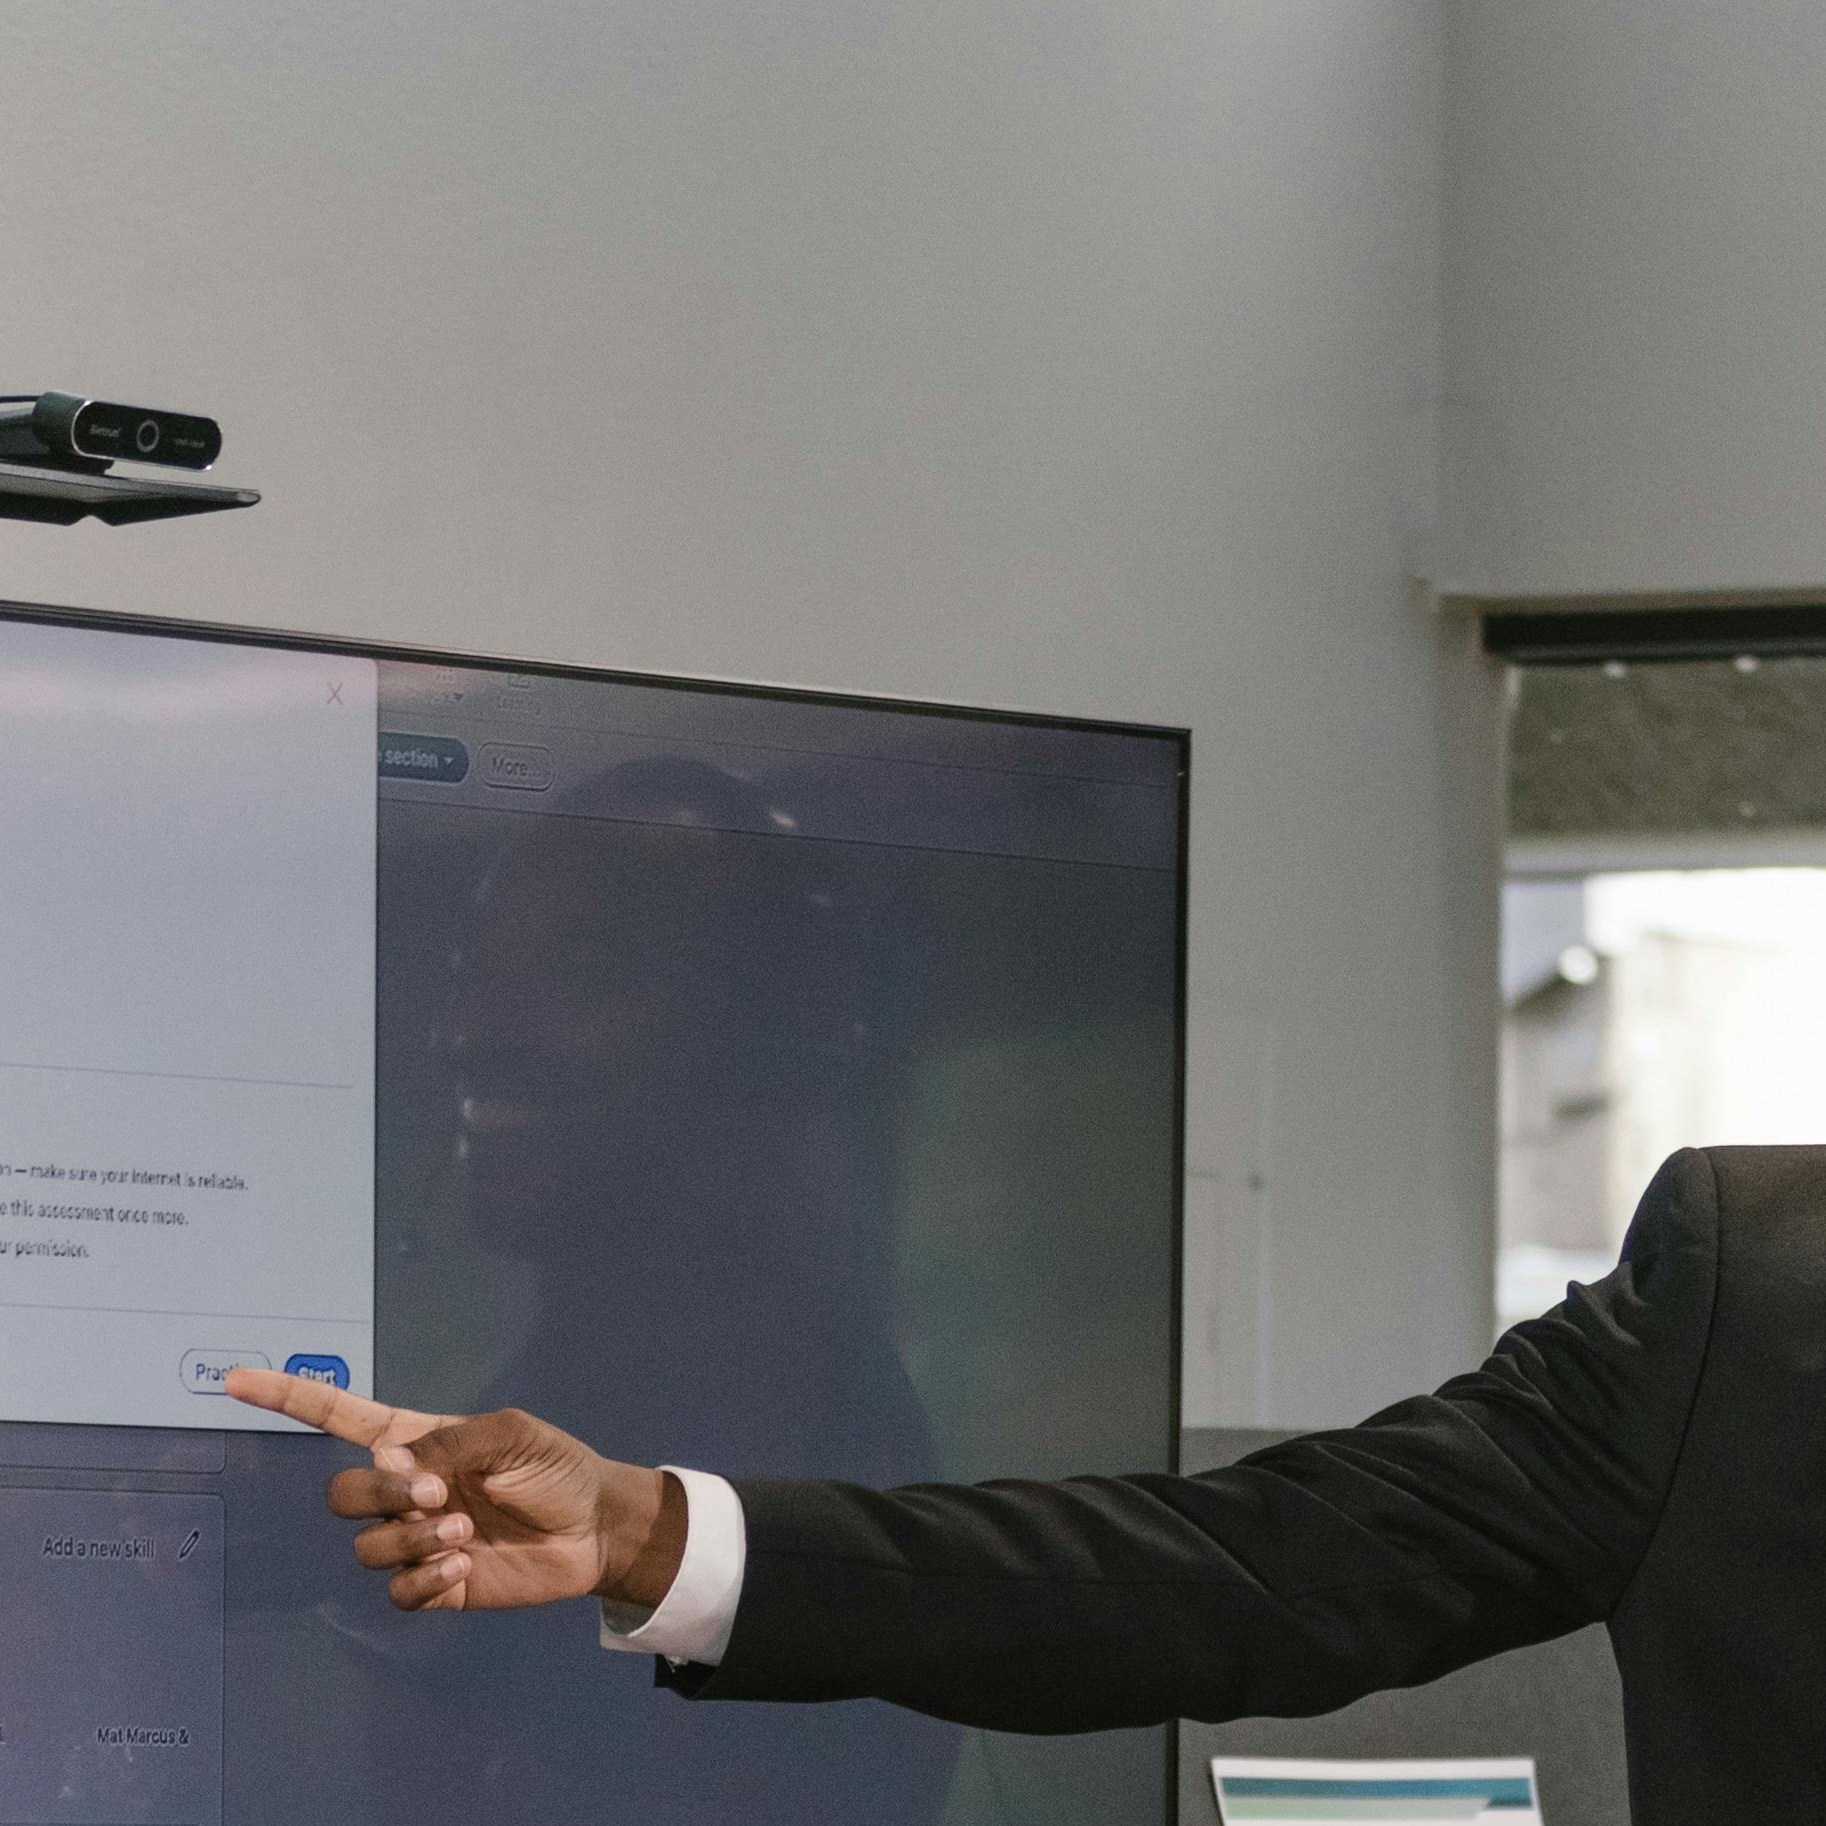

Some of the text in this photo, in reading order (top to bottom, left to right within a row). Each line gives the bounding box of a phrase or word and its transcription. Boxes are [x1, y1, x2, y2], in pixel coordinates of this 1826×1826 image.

[385, 747, 439, 769] section
[44, 1538, 153, 1557] Add a new skill
